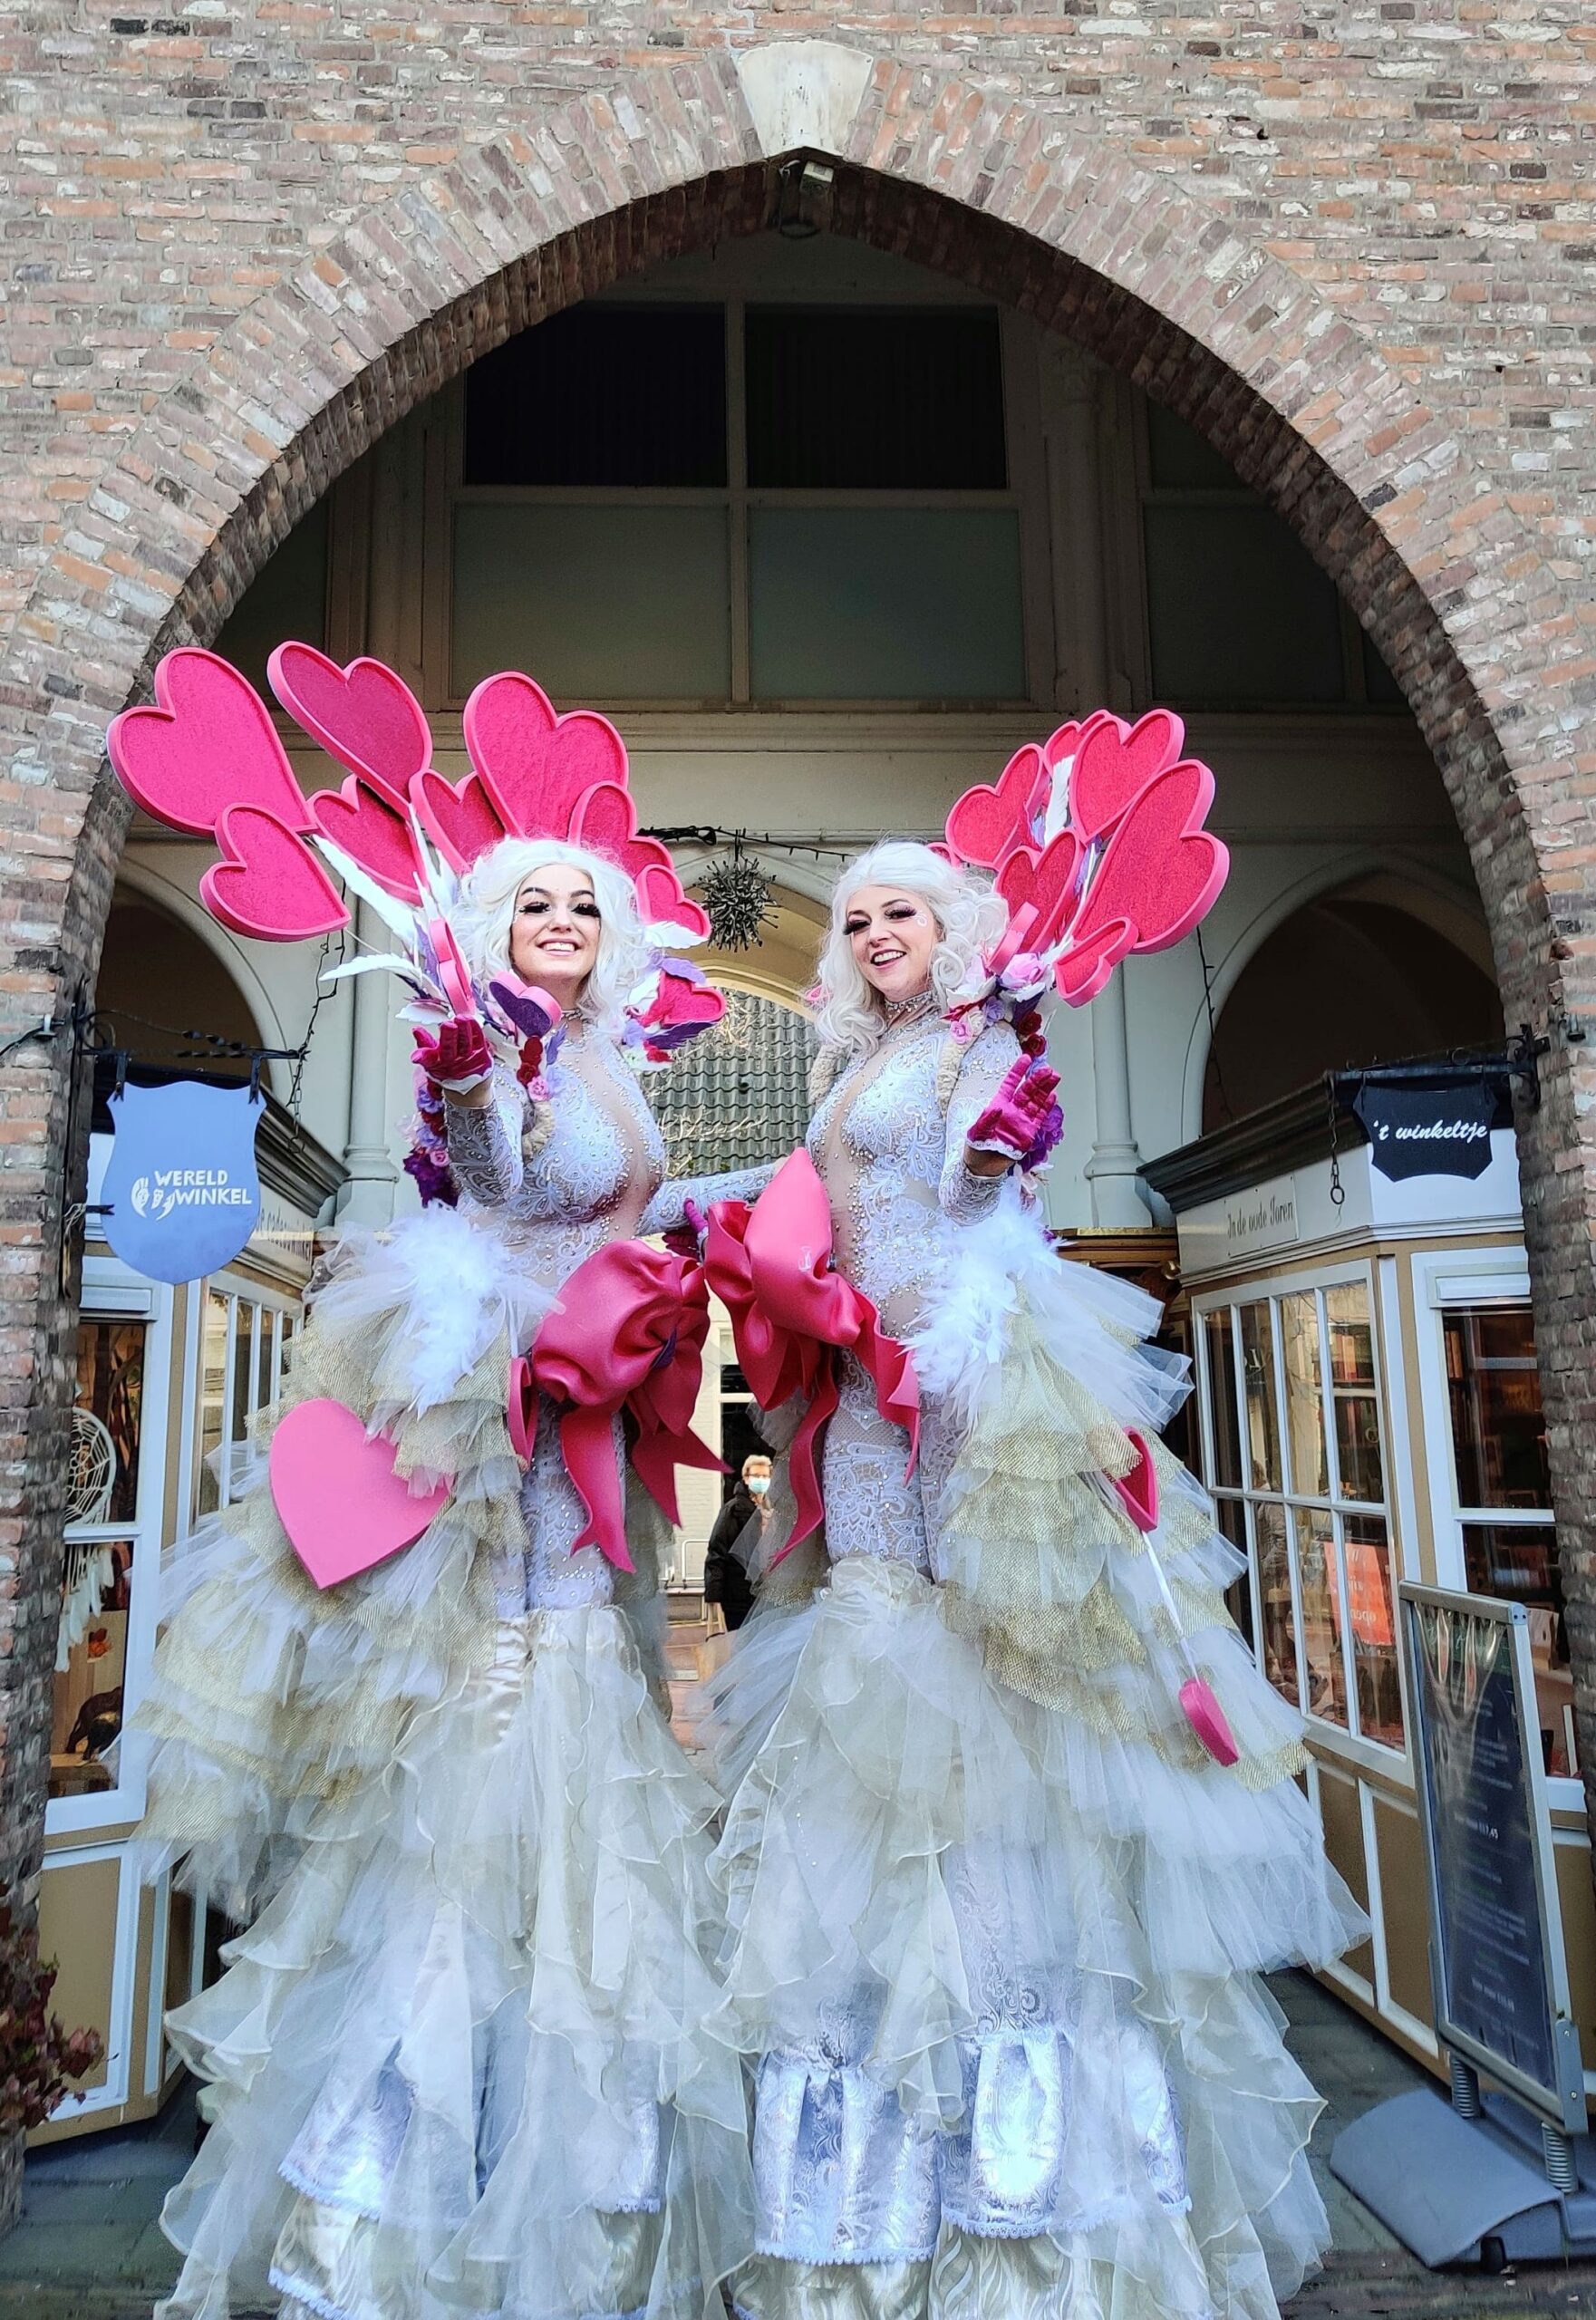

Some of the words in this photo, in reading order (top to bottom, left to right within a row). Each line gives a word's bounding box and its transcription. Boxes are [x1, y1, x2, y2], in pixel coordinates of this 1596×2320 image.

[1373, 1120, 1389, 1141] 't
[1396, 1119, 1487, 1144] winkeltje
[154, 1169, 228, 1187] WERELD
[174, 1188, 253, 1205] WINKEL
[1237, 1207, 1246, 1235] de
[1248, 1201, 1267, 1232] oude
